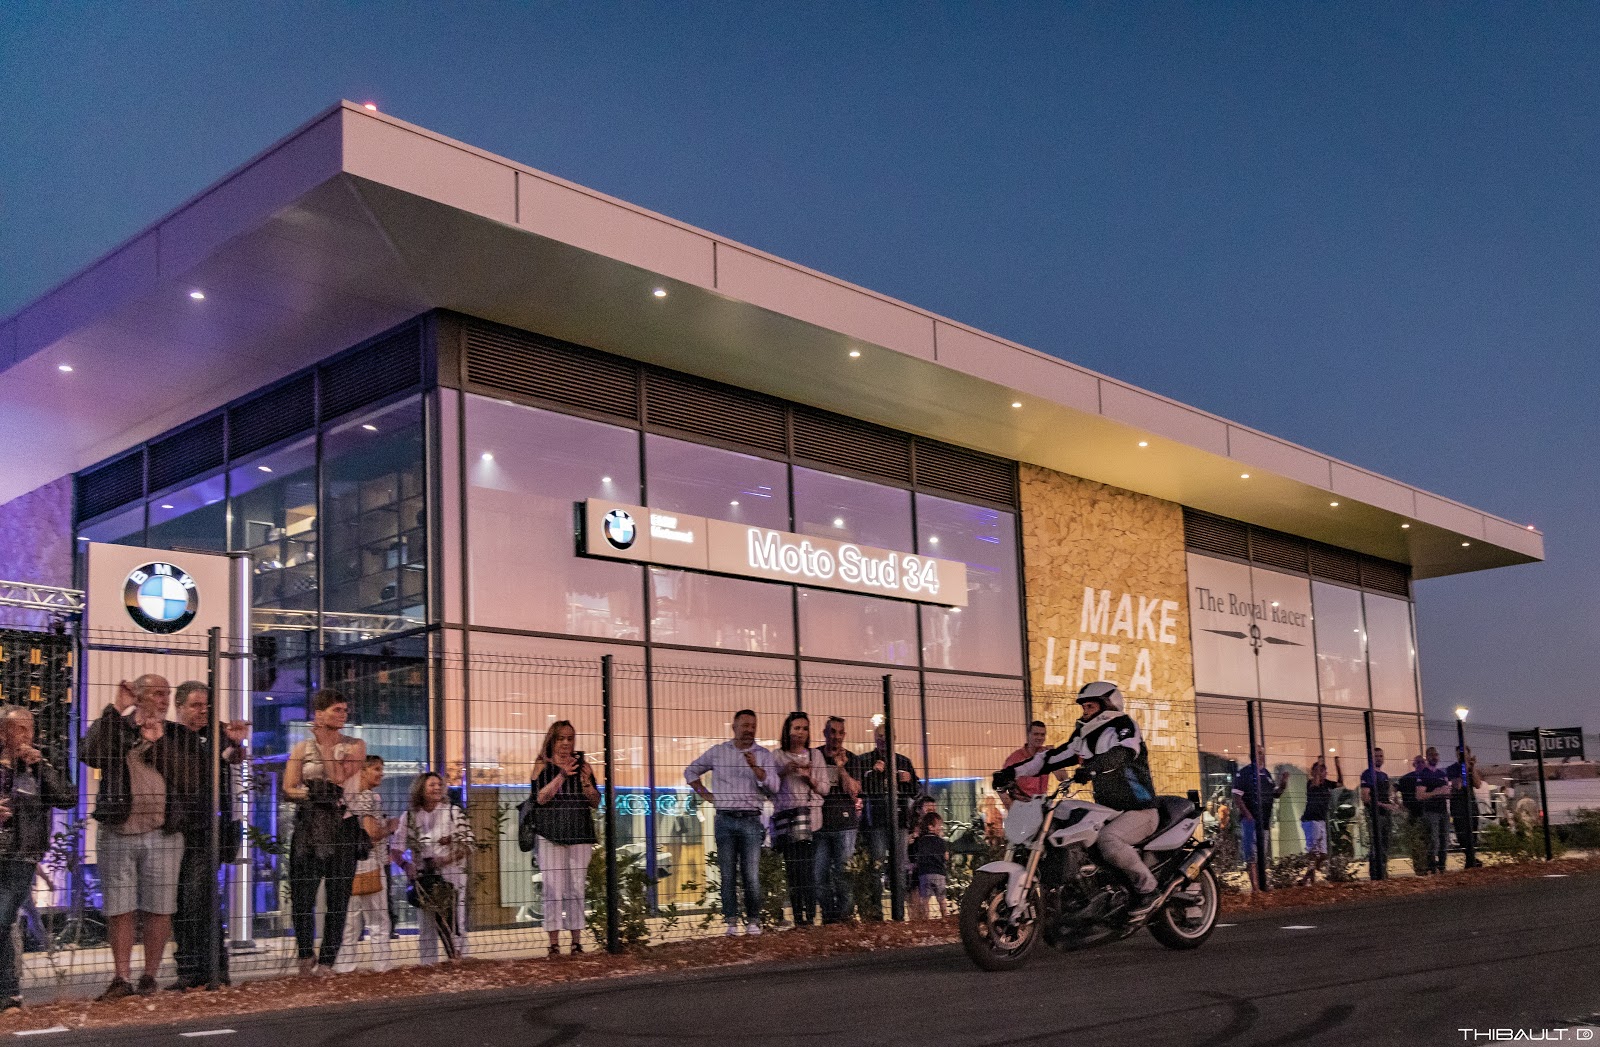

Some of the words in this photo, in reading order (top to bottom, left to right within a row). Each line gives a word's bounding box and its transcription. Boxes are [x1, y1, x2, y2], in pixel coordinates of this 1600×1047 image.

[130, 563, 196, 590] BMW
[747, 528, 836, 579] Moto
[838, 544, 900, 589] Sud
[902, 556, 940, 595] 34
[1080, 586, 1180, 645] MAKE
[1195, 586, 1225, 613] The
[1227, 592, 1268, 625] Royal
[1271, 600, 1308, 628] Racer
[1044, 636, 1120, 687] LIFE
[1129, 647, 1153, 693] A
